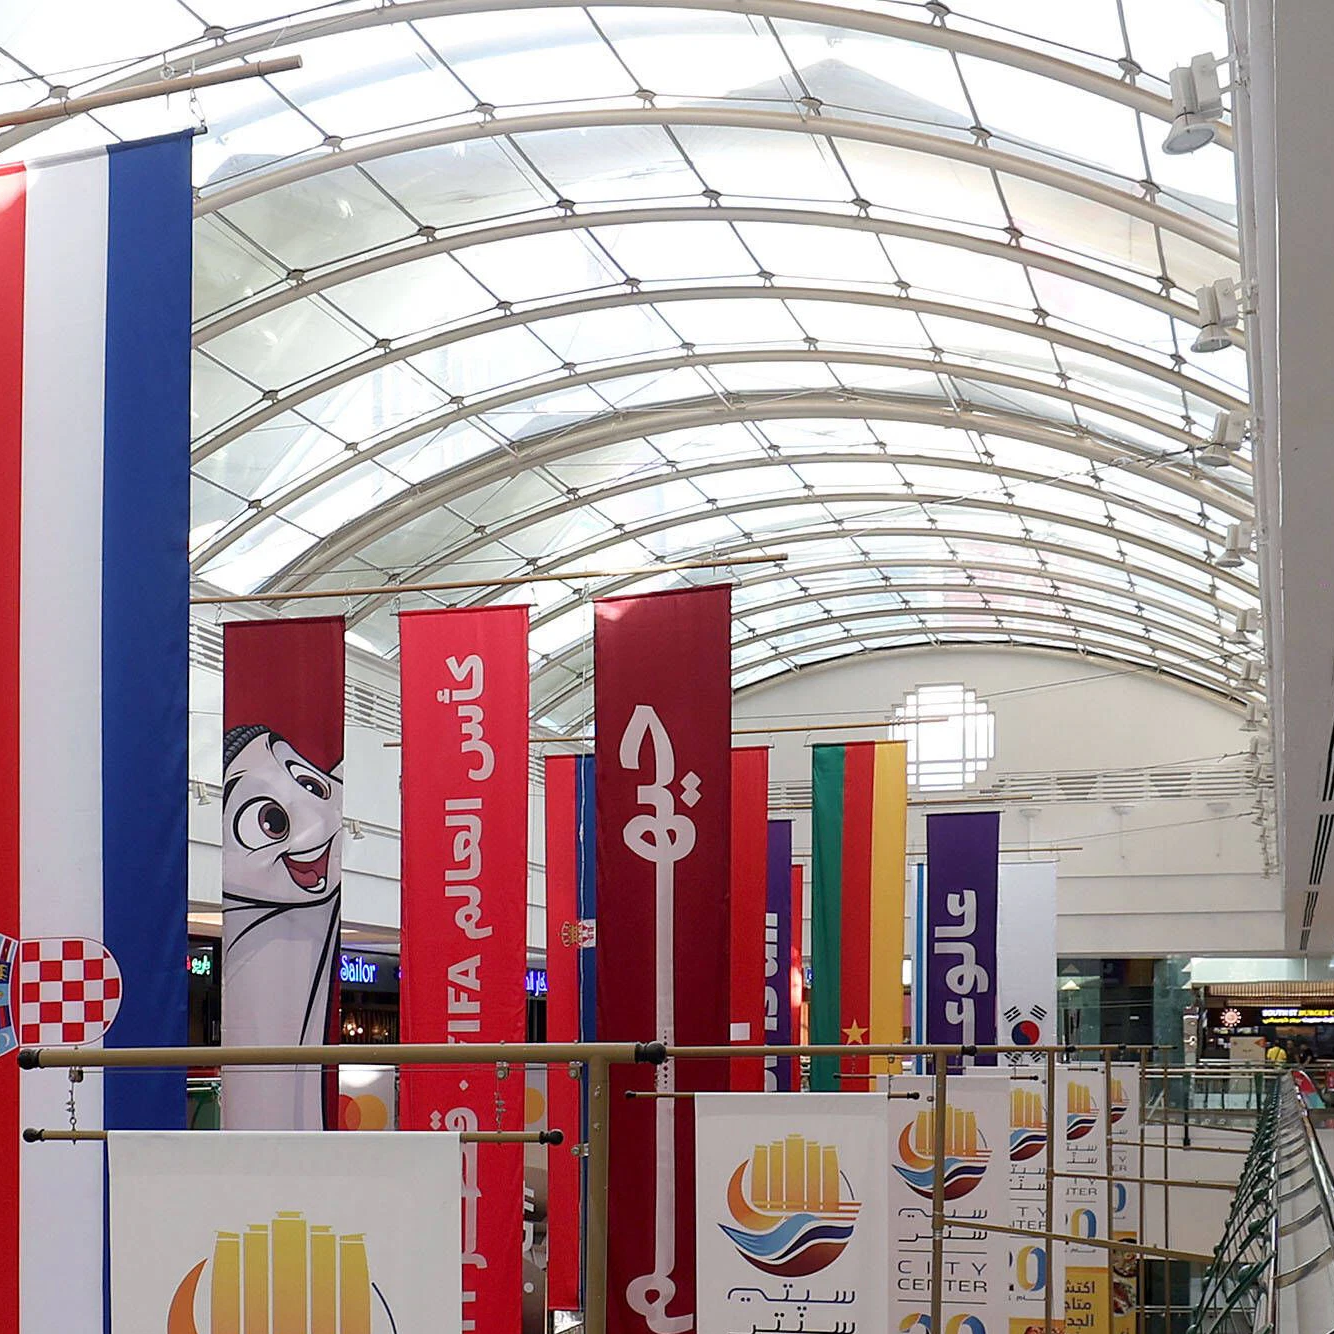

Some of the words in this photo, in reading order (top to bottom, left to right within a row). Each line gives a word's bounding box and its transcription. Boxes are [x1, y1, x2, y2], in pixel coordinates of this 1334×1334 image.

[340, 954, 376, 983] Sailor
[897, 1259, 988, 1277] CITY
[727, 1282, 856, 1311] سيتي
